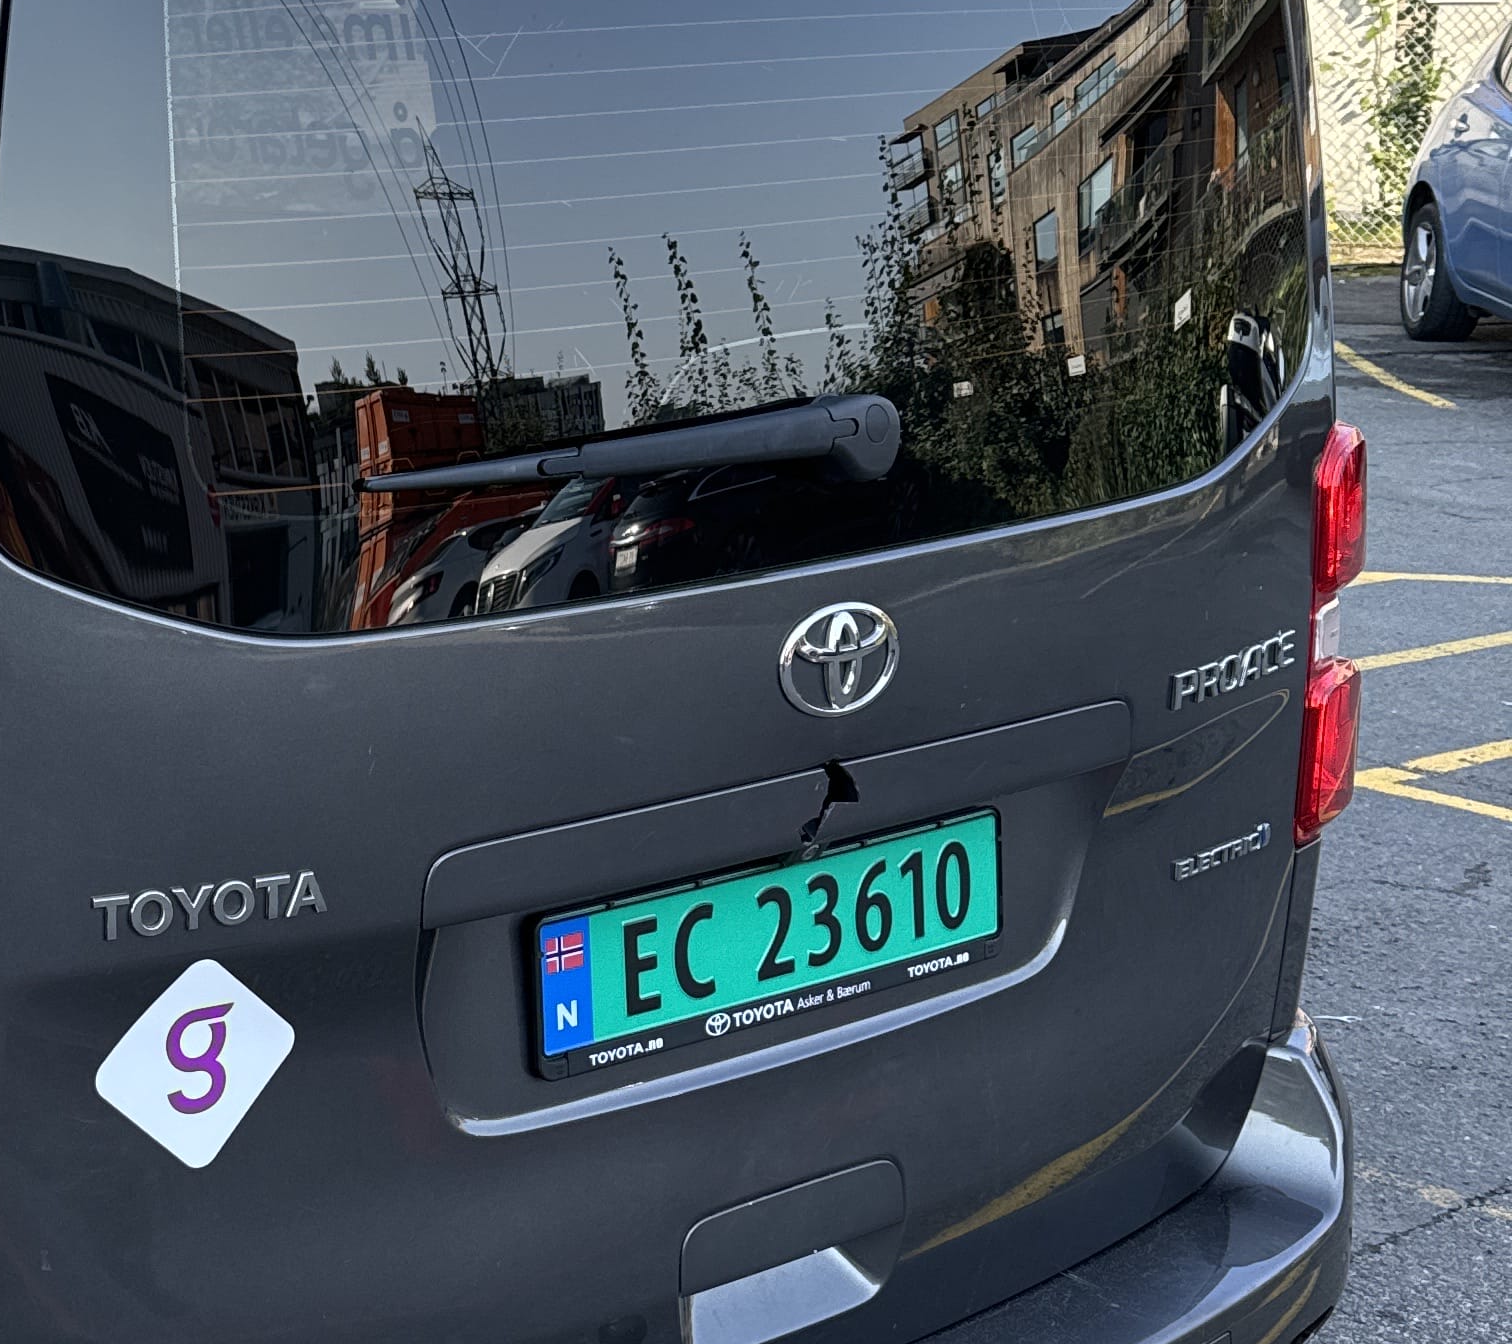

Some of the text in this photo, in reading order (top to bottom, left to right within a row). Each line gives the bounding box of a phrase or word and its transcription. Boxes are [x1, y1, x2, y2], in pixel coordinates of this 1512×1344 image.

[1169, 629, 1296, 712] PROACE
[1171, 830, 1261, 882] ELECTRIC
[90, 868, 329, 942] TOYOTA
[621, 839, 972, 1017] EC 23610
[555, 998, 579, 1032] N
[732, 979, 872, 1028] TOYOTA Asker & Bærum
[589, 1037, 664, 1067] TOYOTA.no
